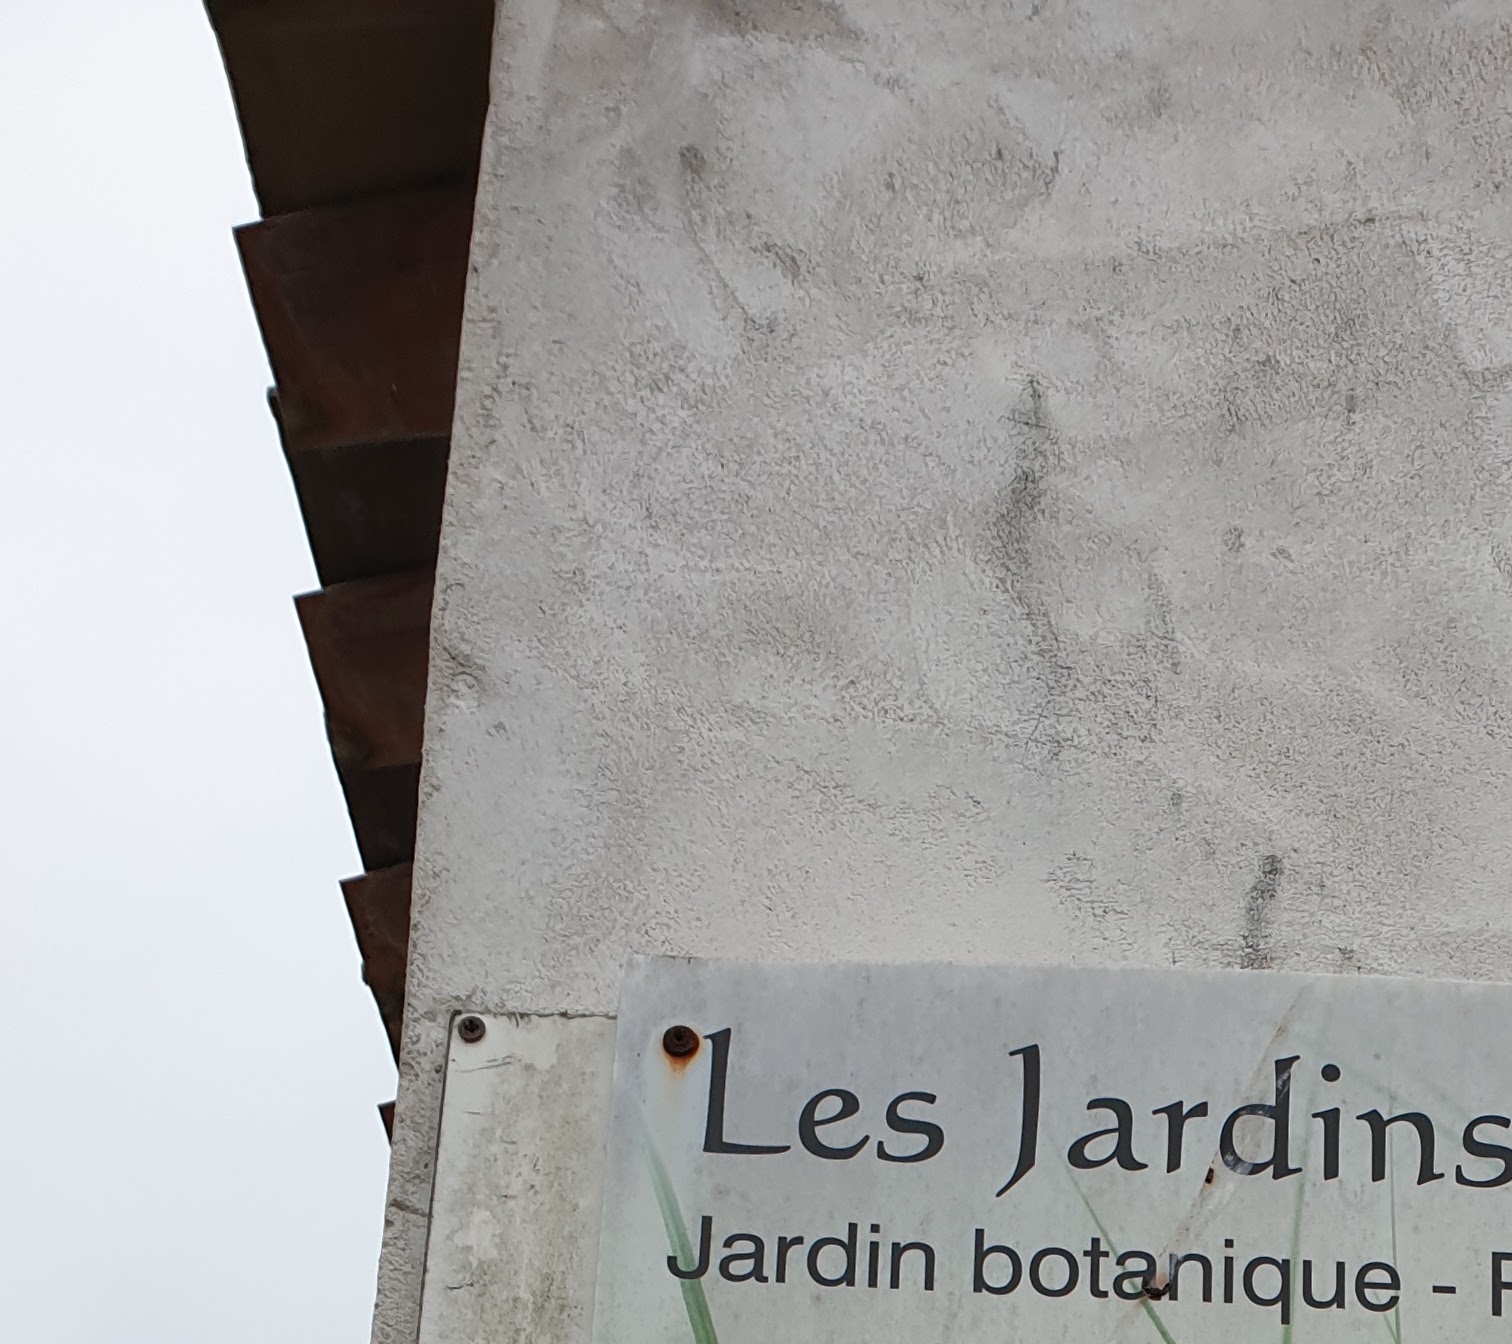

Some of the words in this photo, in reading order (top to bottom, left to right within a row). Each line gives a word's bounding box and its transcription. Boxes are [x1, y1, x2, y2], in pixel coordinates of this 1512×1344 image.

[702, 1027, 946, 1163] Les
[666, 1215, 936, 1291] Jardin
[972, 1228, 1402, 1325] botanique
